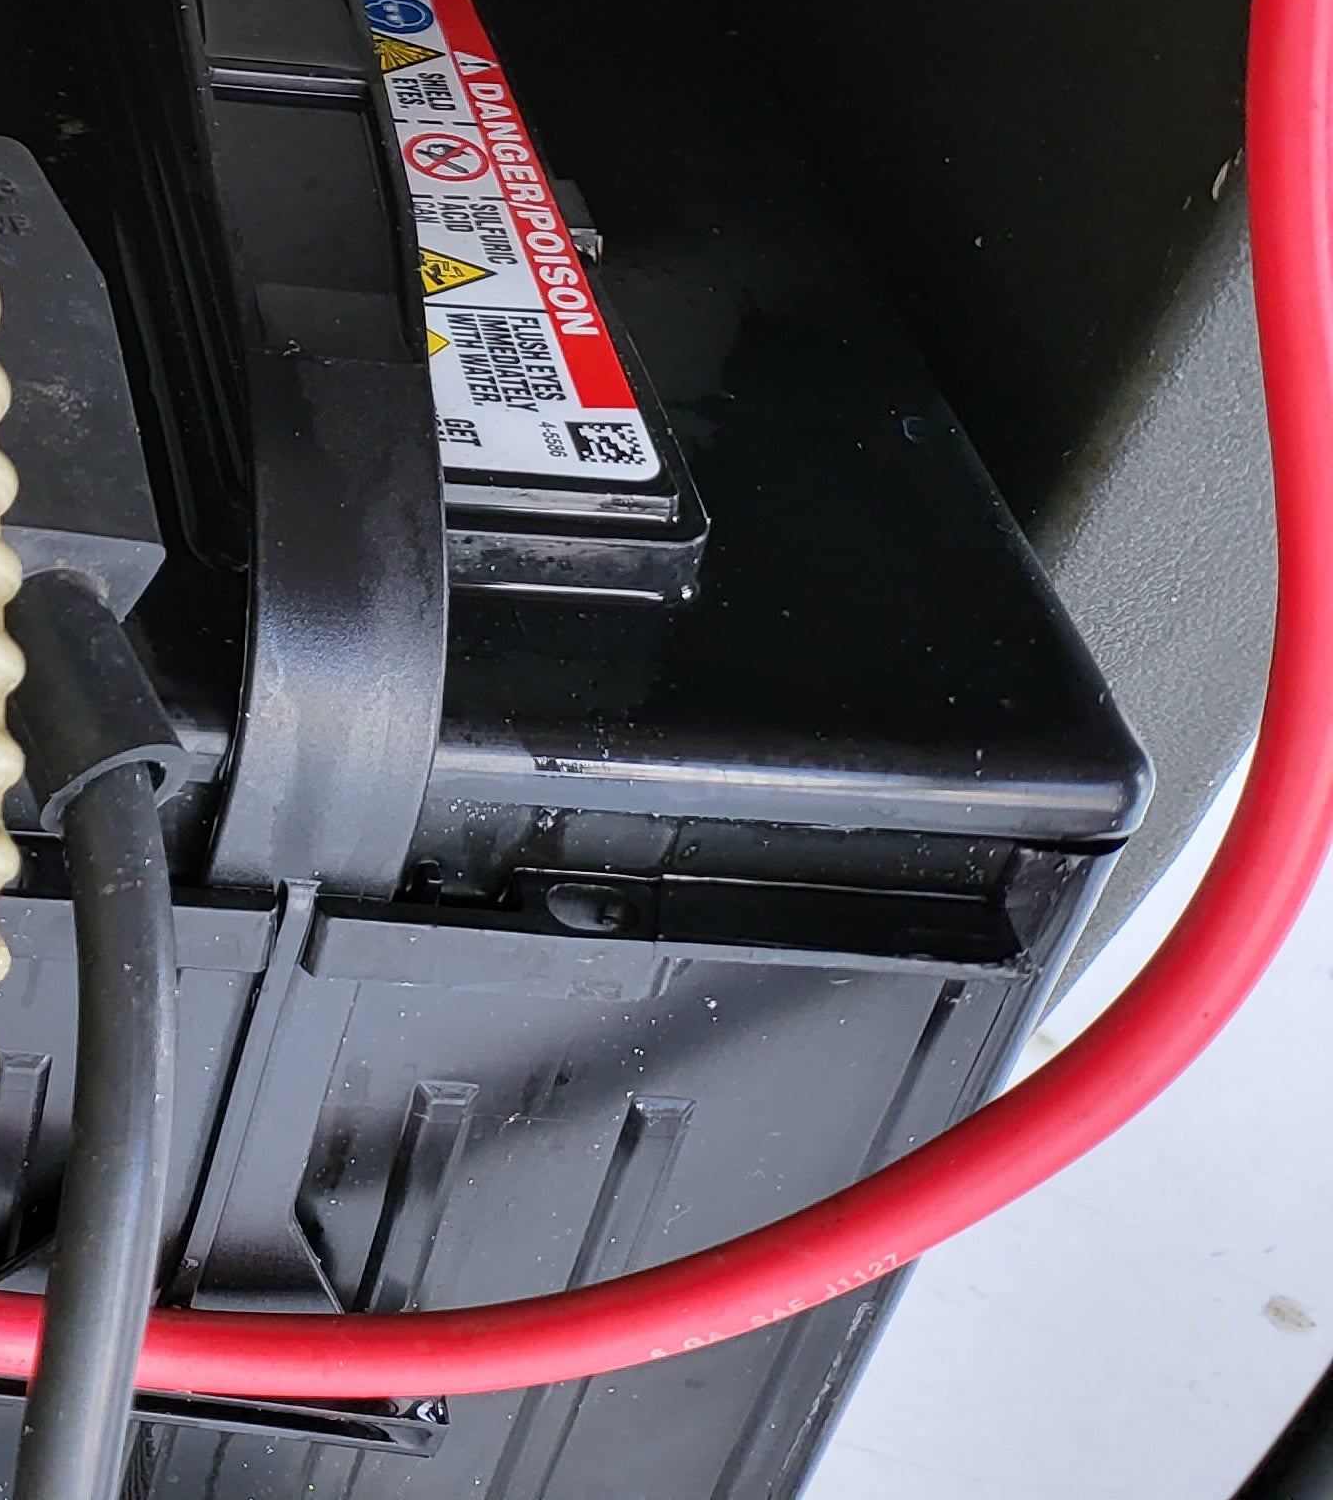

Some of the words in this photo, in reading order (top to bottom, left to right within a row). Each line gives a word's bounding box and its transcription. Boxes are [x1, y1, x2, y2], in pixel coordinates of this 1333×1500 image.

[417, 72, 456, 111] SHIELD
[414, 201, 440, 223] CAN
[437, 201, 474, 233] ACID
[472, 82, 601, 337] DANGER/POISON
[469, 203, 518, 266] SULFURIC
[445, 313, 485, 350] WITH
[508, 316, 552, 360] FLUSH
[477, 314, 539, 413] IMMEDIATELY
[525, 364, 567, 401] EYES
[443, 418, 482, 448] GET
[539, 421, 568, 458] 4-5586
[749, 1297, 807, 1326] SAE
[824, 1252, 898, 1298] J1127
